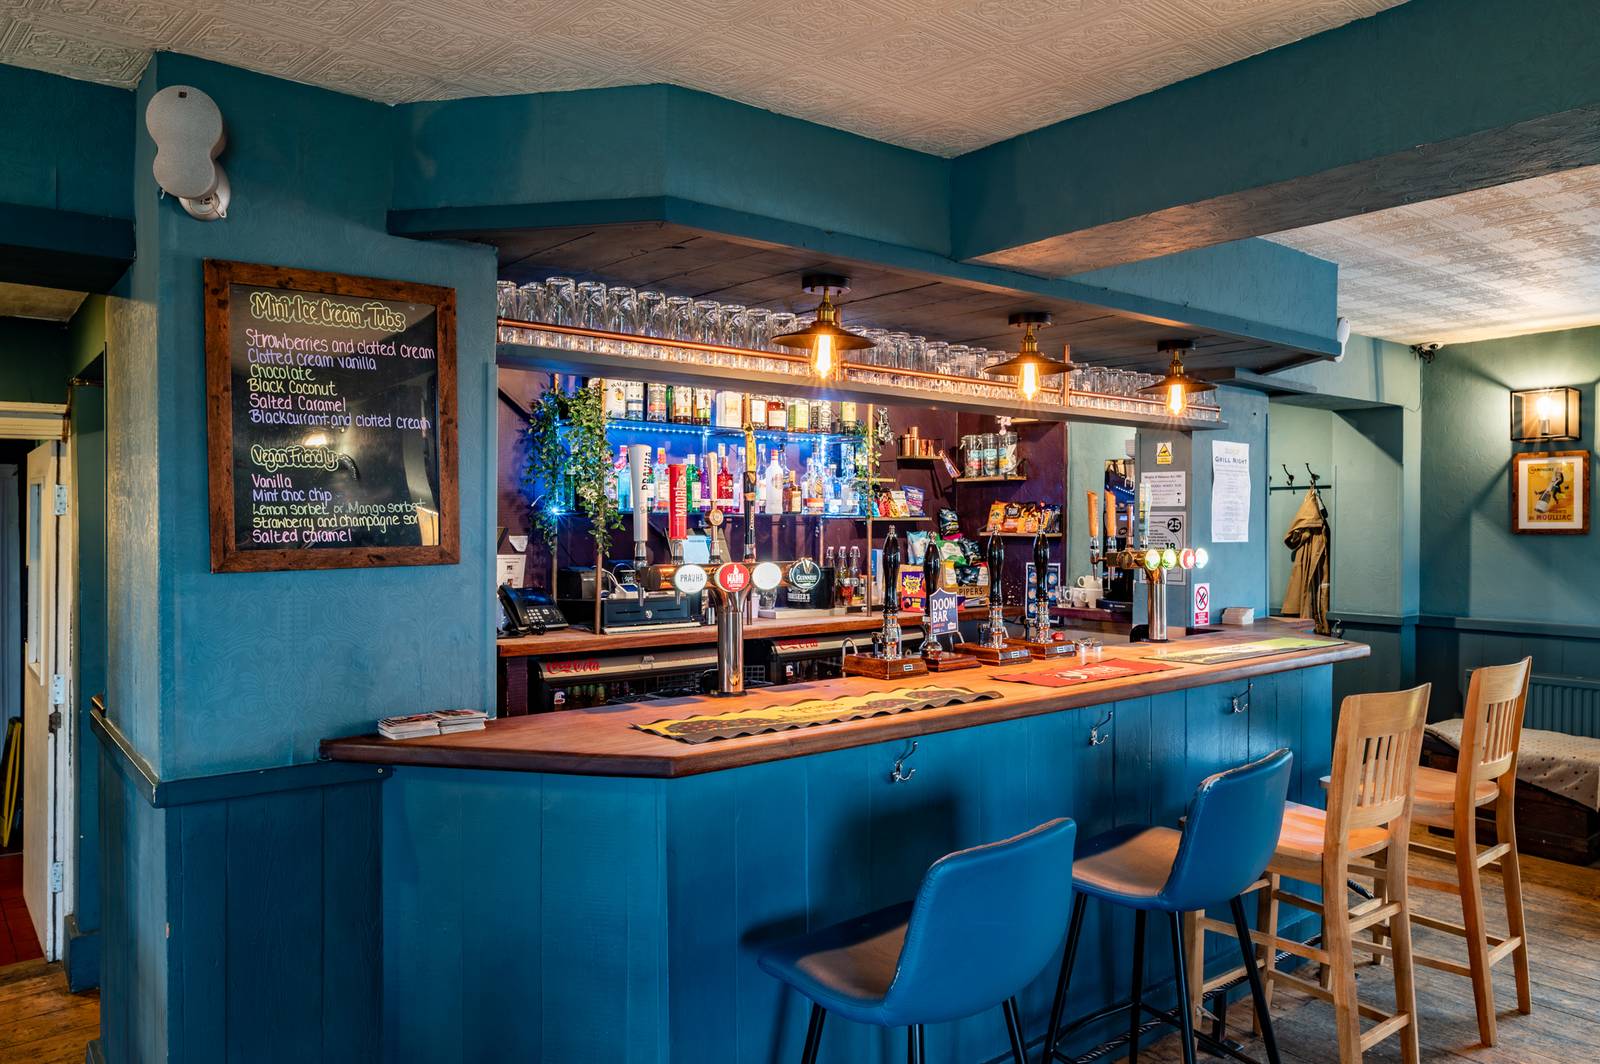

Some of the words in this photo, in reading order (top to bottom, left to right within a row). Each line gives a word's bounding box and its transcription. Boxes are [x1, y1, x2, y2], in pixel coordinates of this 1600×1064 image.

[255, 294, 288, 318] Mini
[297, 298, 318, 320] Ice
[321, 300, 361, 324] Cream
[367, 307, 402, 327] Tubs
[245, 328, 329, 353] Strawberries
[331, 339, 354, 354] and
[357, 340, 396, 356] clotted
[400, 344, 435, 359] cream
[248, 347, 294, 365] Clotted
[296, 352, 333, 367] cream
[337, 355, 376, 370] vanilla
[250, 364, 316, 381] Chocolate
[247, 378, 286, 394] Black
[289, 380, 338, 396] Coconut
[249, 393, 292, 410] Salted
[298, 395, 346, 412] Caramel
[248, 408, 329, 425] Blackcurrant
[331, 412, 351, 426] and
[355, 413, 391, 427] clotted
[396, 416, 430, 430] cream
[253, 448, 288, 468] Vegan
[288, 447, 335, 468] Friendly
[1215, 456, 1231, 464] GRILL
[251, 473, 292, 488] Vanilla
[253, 488, 278, 502] Mint
[281, 489, 306, 501] choc
[308, 487, 332, 507] chip
[252, 503, 288, 515] Lemon
[290, 502, 329, 515] sorbet
[333, 504, 343, 514] or
[349, 500, 385, 516] Mango
[387, 498, 426, 514] sorbet
[317, 514, 338, 527] and
[340, 514, 400, 533] champagne
[1168, 519, 1181, 530] 25
[252, 528, 298, 543] Salted
[302, 527, 351, 543] caramel
[932, 596, 956, 611] DOOM
[932, 609, 949, 624] BAR
